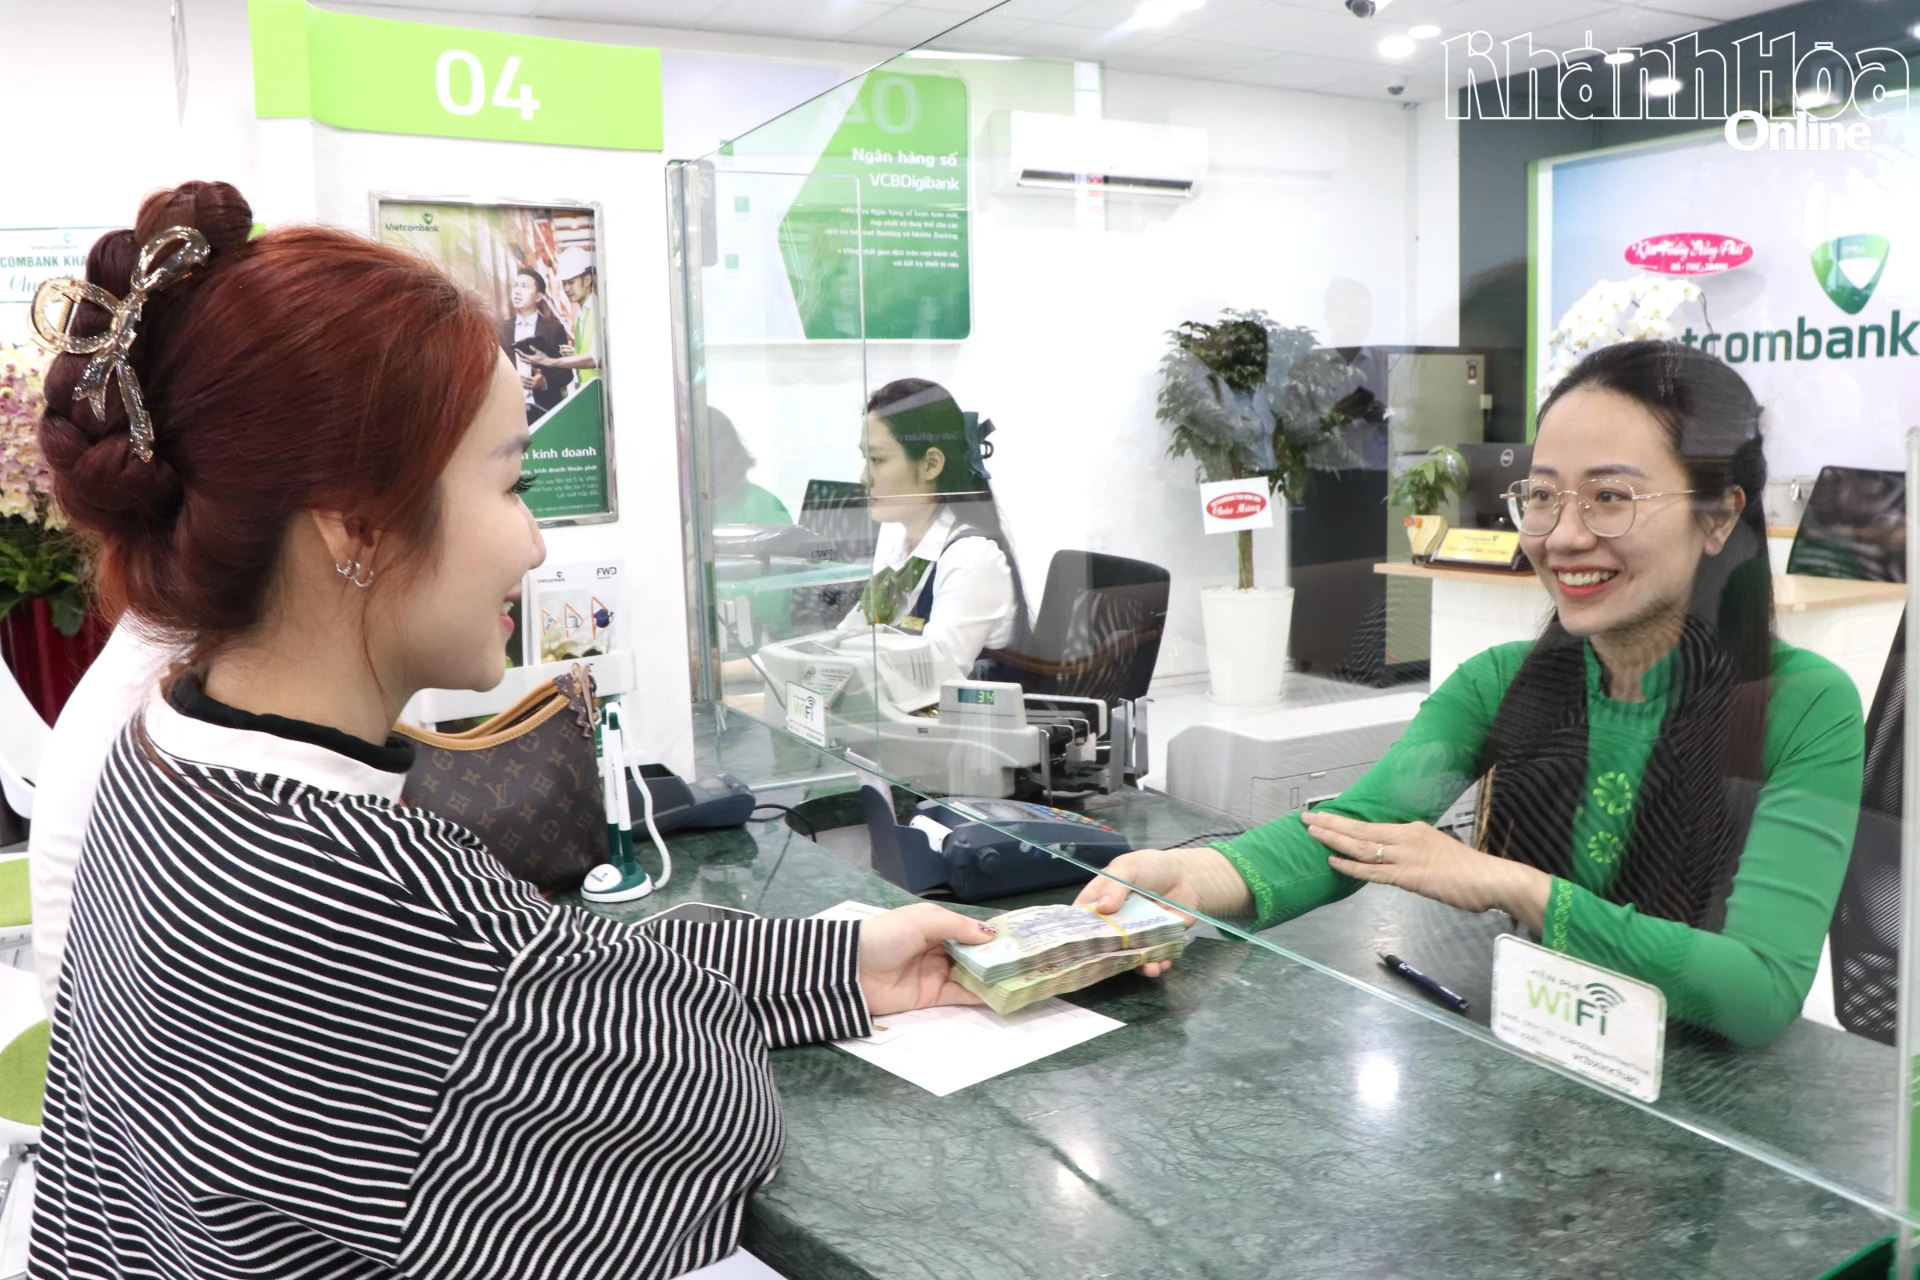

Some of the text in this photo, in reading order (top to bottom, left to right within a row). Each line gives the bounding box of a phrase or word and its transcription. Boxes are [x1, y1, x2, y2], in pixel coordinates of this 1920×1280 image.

[435, 49, 541, 121] 04
[852, 148, 959, 168] Ngân hàng số
[869, 173, 959, 191] VCBDigibank
[385, 223, 439, 232] Vietcombank
[1672, 310, 1920, 363] tcombank
[532, 448, 558, 460] kinh
[562, 446, 596, 458] doanh
[596, 567, 617, 576] FWD
[793, 701, 814, 722] WiFi
[1526, 978, 1607, 1036] WiFi
